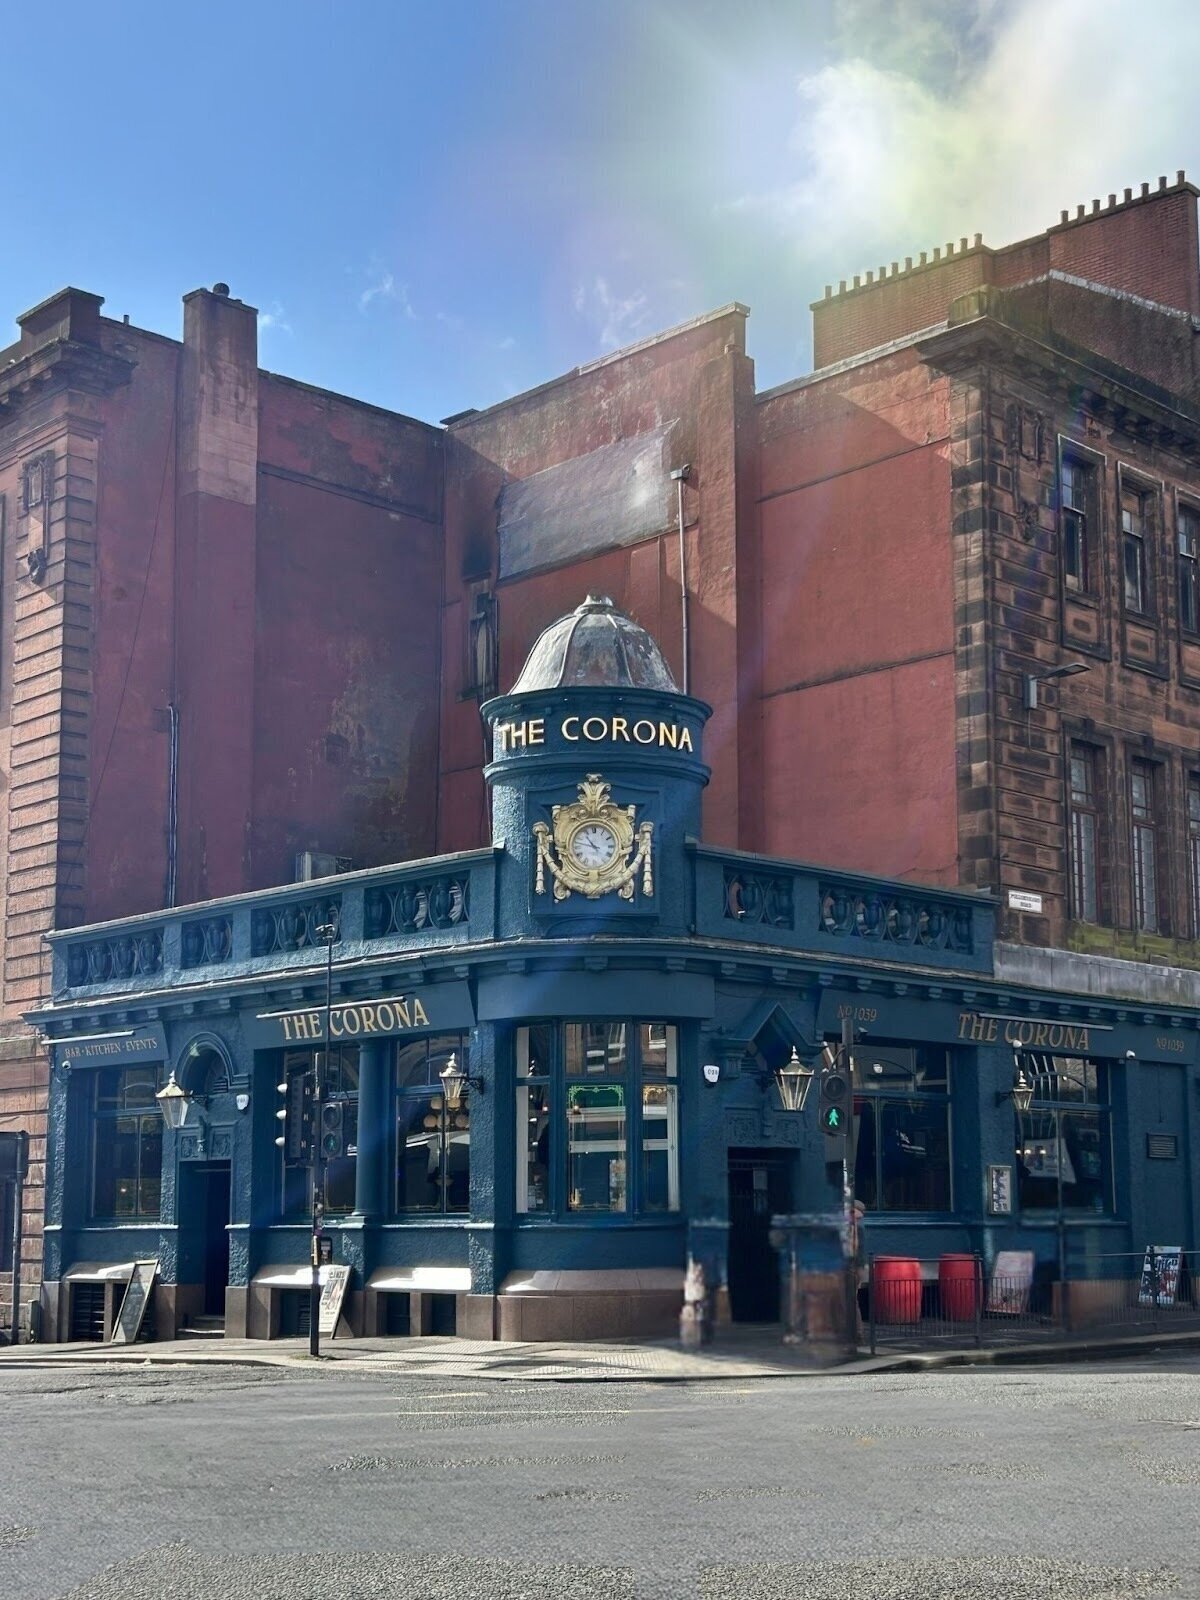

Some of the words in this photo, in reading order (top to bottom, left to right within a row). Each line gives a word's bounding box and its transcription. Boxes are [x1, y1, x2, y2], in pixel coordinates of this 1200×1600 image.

[499, 718, 545, 751] THE
[561, 716, 694, 752] CORONA
[279, 1012, 323, 1041] THE
[329, 998, 431, 1037] CORONA
[957, 1013, 999, 1042] THE
[1004, 1020, 1090, 1051] CORONA
[64, 1046, 81, 1059] BAR
[84, 1042, 121, 1057] KITCHEN
[125, 1038, 158, 1052] EVENTS
